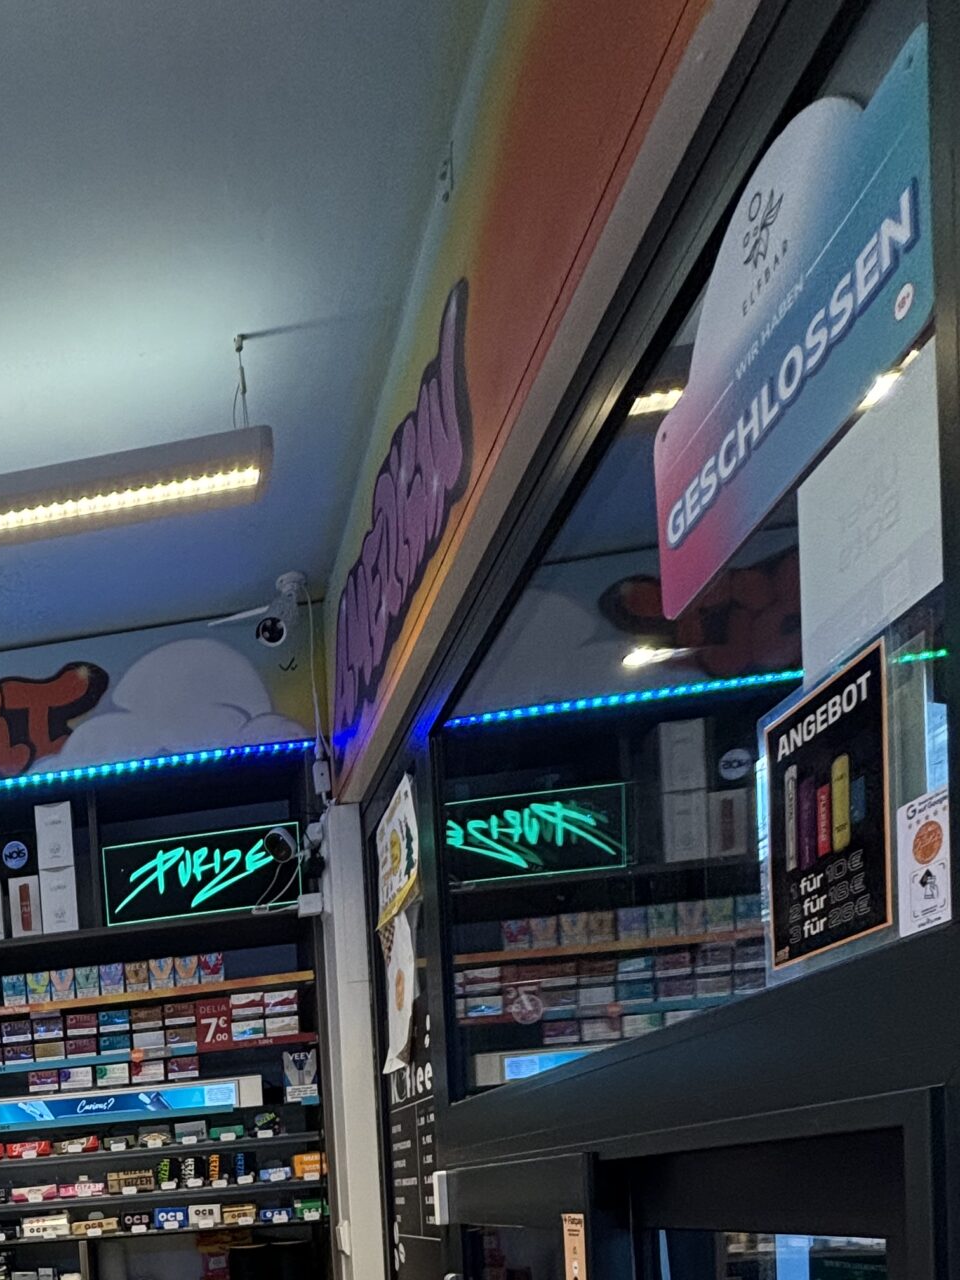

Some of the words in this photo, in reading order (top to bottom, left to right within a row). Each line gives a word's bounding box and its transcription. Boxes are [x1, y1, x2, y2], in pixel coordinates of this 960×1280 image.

[742, 237, 790, 318] ELFBAR
[736, 344, 760, 380] WIR
[760, 277, 806, 343] HABEN
[667, 180, 917, 548] GESCHLOSSEN
[777, 671, 872, 763] ANGEBOT
[799, 872, 824, 896] für
[825, 849, 864, 883] 10€
[789, 903, 801, 923] 2
[803, 894, 827, 916] für
[789, 925, 802, 945] 3
[803, 916, 827, 938] für
[199, 1004, 227, 1016] DELIA
[289, 1052, 312, 1061] VEEV
[76, 1098, 115, 1114] Curious?
[124, 1177, 152, 1187] GIZEH
[124, 1214, 150, 1225] OCB
[158, 1211, 184, 1222] OCB
[194, 1207, 215, 1217] OCB
[84, 1220, 105, 1230] OCB
